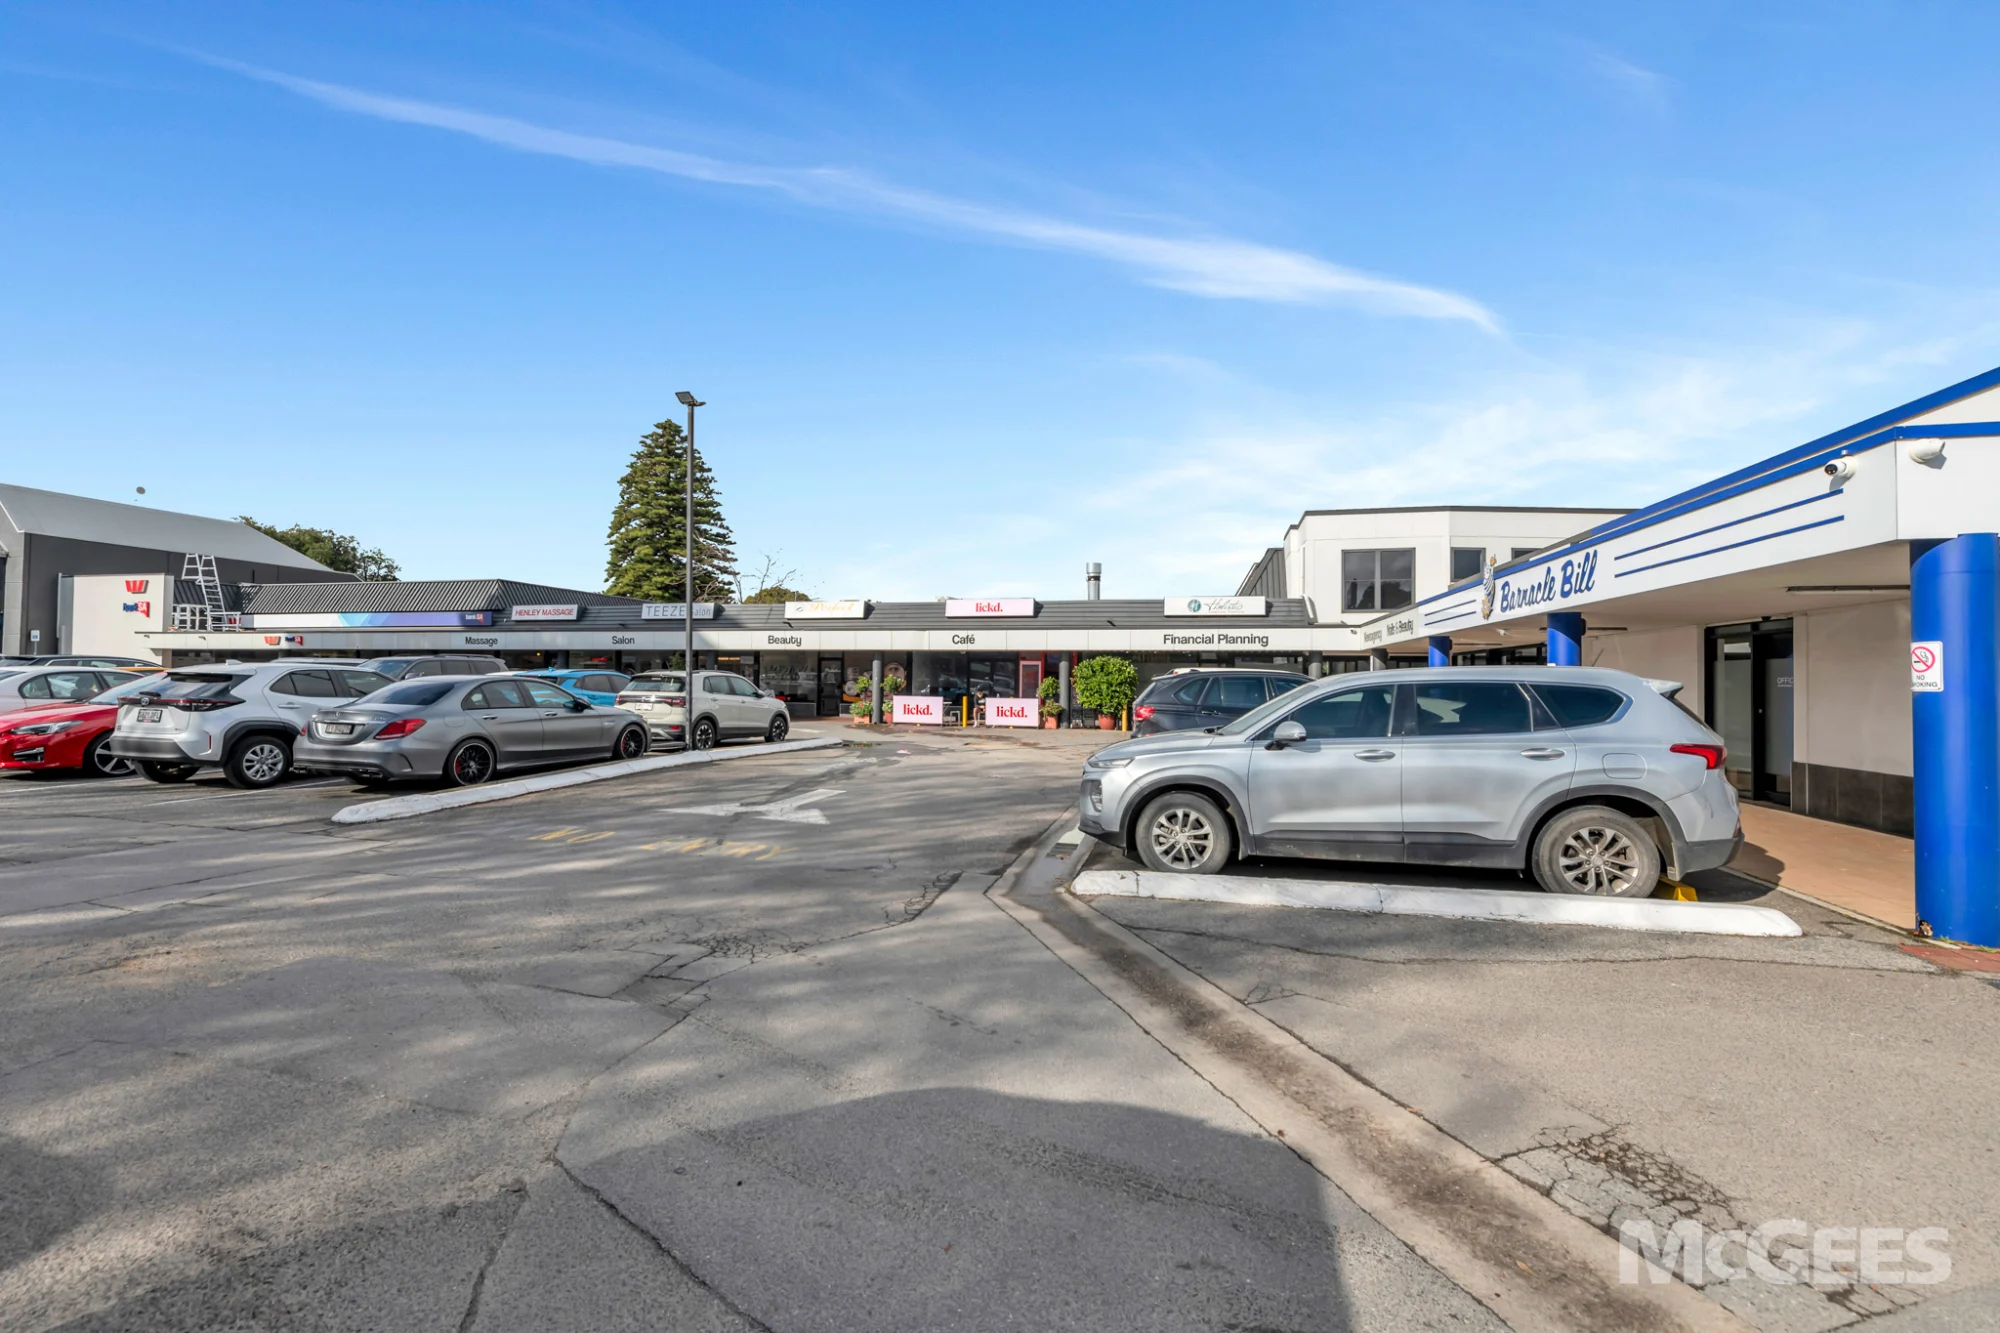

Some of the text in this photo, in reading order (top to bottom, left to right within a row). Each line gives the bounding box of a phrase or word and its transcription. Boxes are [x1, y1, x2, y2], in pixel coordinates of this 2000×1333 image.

[1500, 549, 1598, 613] Barnacle Bill
[515, 608, 574, 617] HENLEY MASSAGE
[645, 605, 686, 617] TEEZE
[975, 602, 1003, 613] lickd.
[465, 636, 499, 647] Massage
[611, 635, 636, 645] Salon
[767, 635, 802, 647] Beauty
[951, 634, 976, 645] Café
[1163, 633, 1269, 648] Financial Planning
[1776, 676, 1794, 684] OFFIC
[903, 703, 933, 716] lickd.
[996, 705, 1028, 718] lickd.
